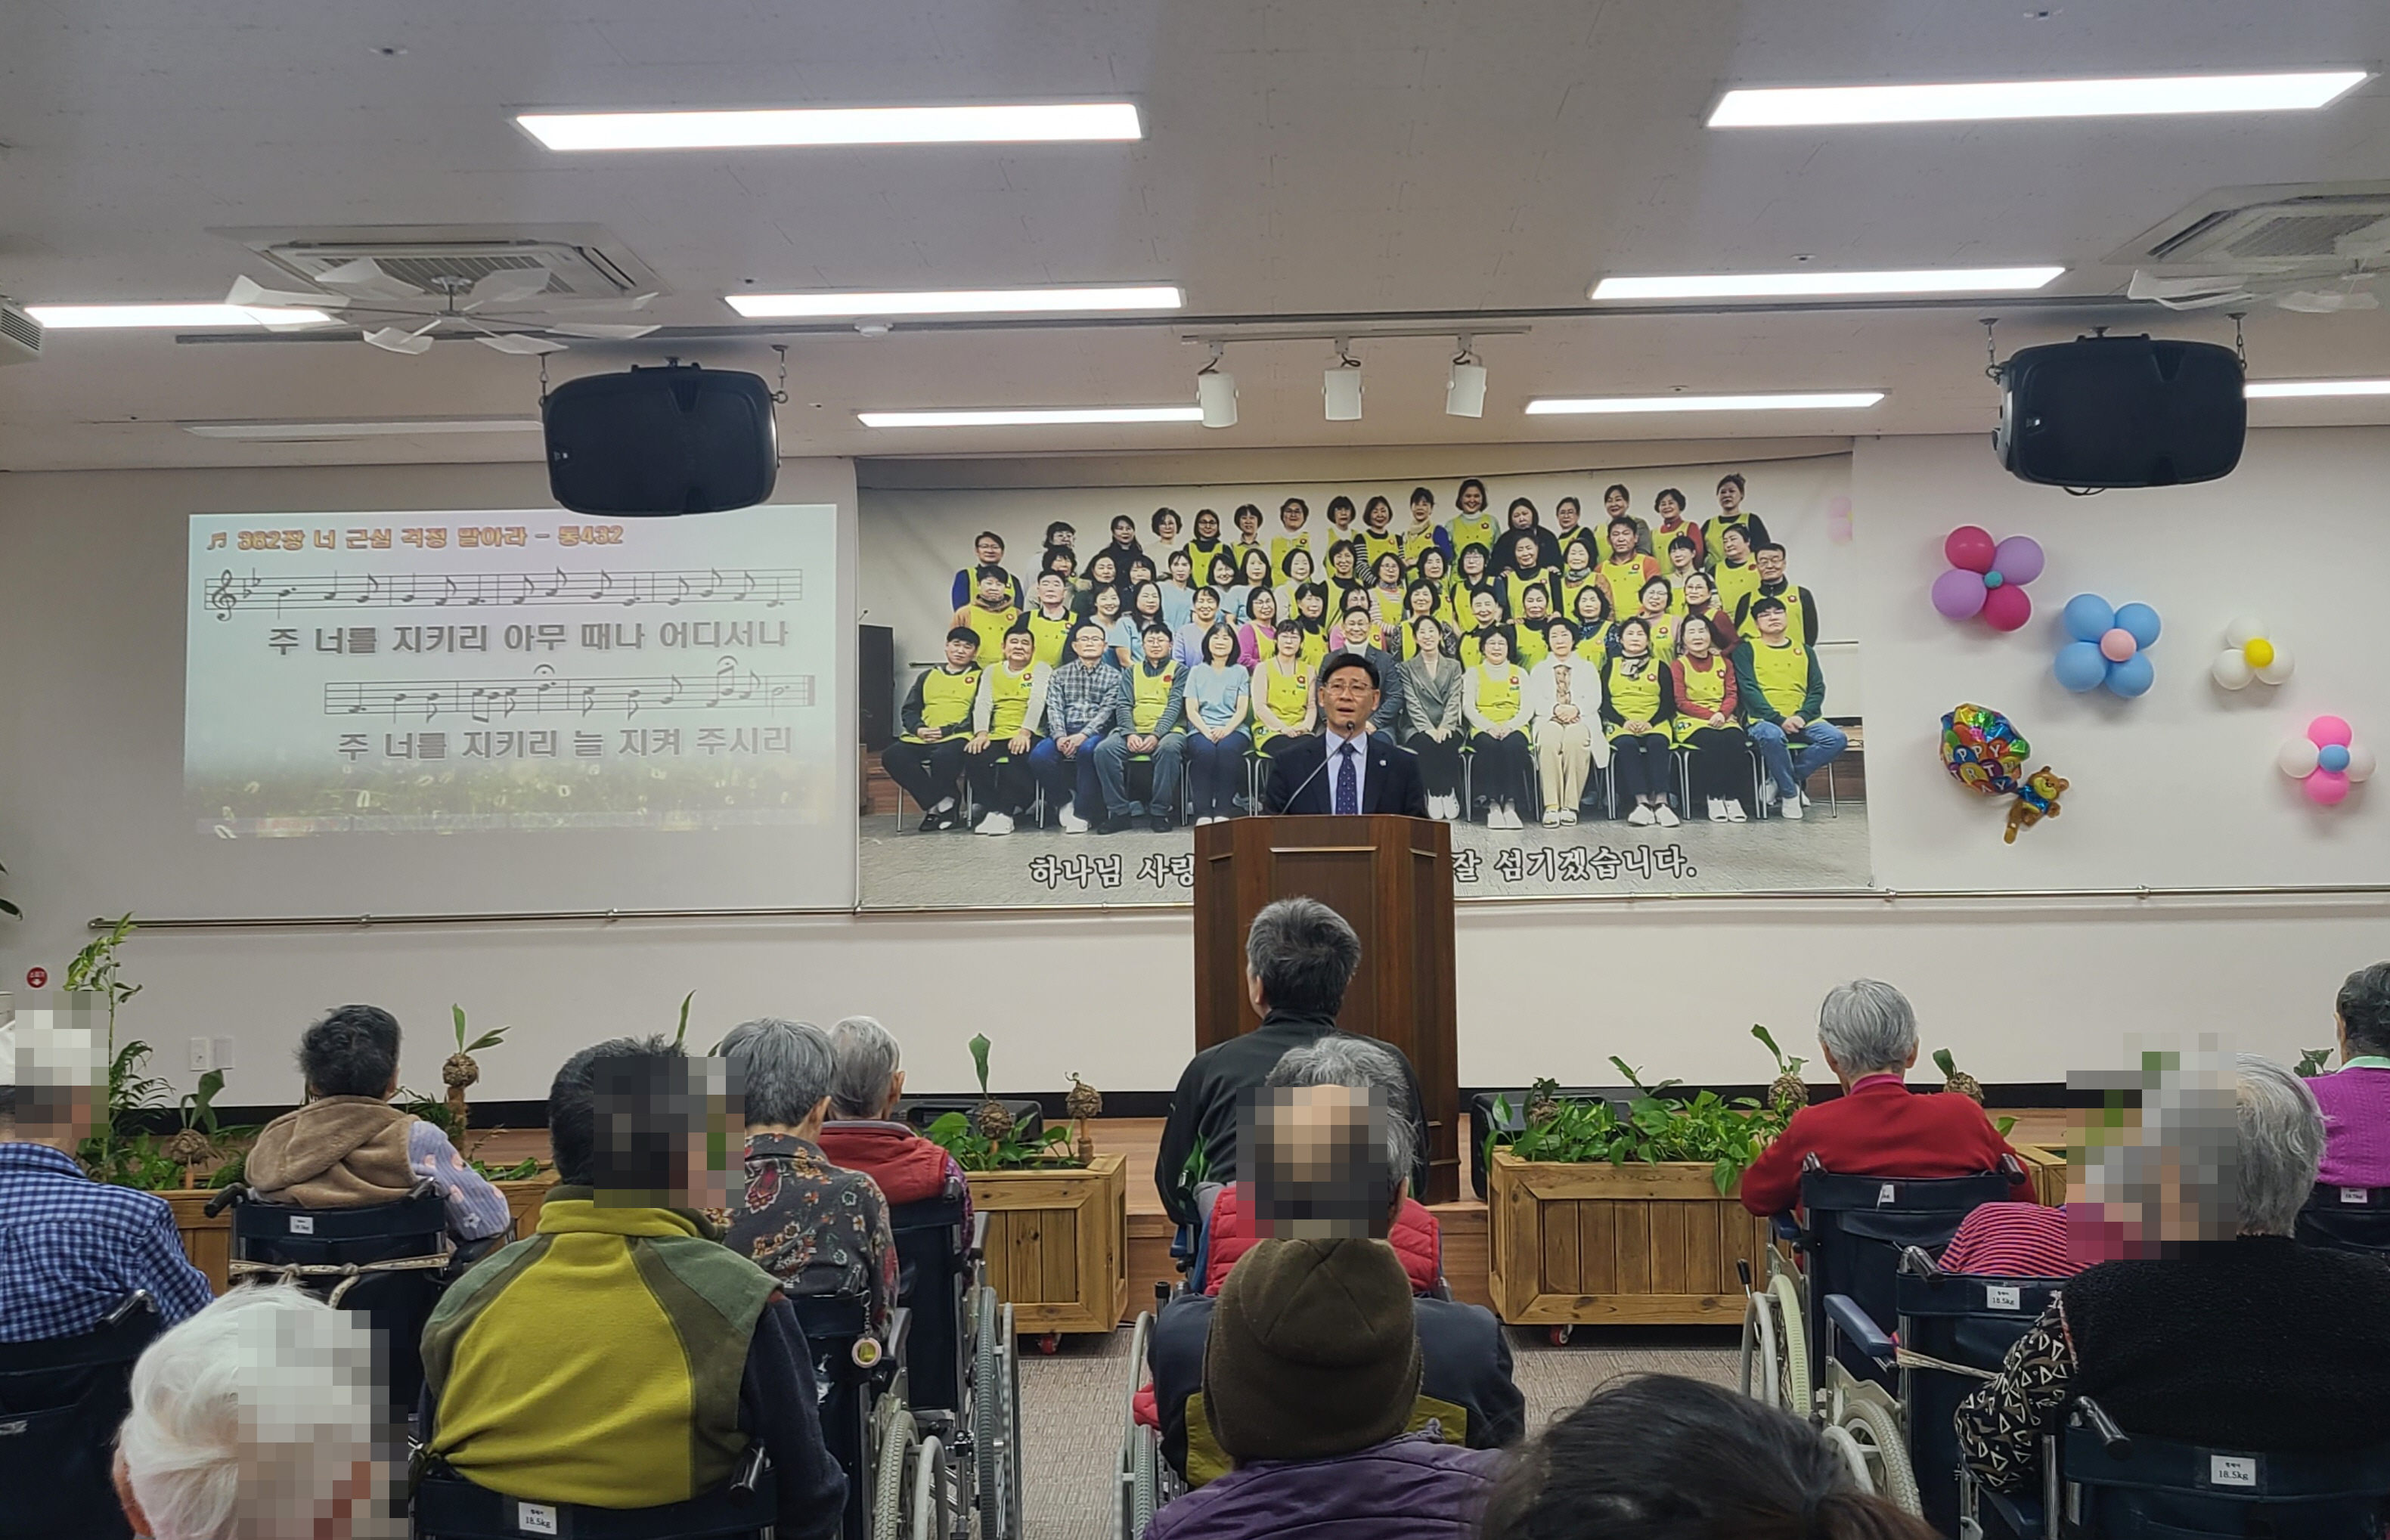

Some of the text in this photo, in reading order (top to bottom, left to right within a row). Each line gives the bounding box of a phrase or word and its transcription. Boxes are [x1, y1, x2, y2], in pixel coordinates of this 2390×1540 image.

[237, 528, 305, 550] 382장
[314, 529, 335, 549] 너
[346, 528, 392, 549] 근심
[401, 528, 448, 549] 걱정
[457, 526, 528, 548] 말아라
[558, 525, 624, 547] 통432
[268, 621, 789, 655] 주 너를 지키리 아무 때나 어디서나
[338, 727, 791, 761] 주 너를 지키리 늘 지켜 주시리
[1029, 854, 1122, 889] 하나님
[1493, 844, 1697, 882] 섬기겠습니다.
[2218, 1470, 2249, 1481] 18.5kg
